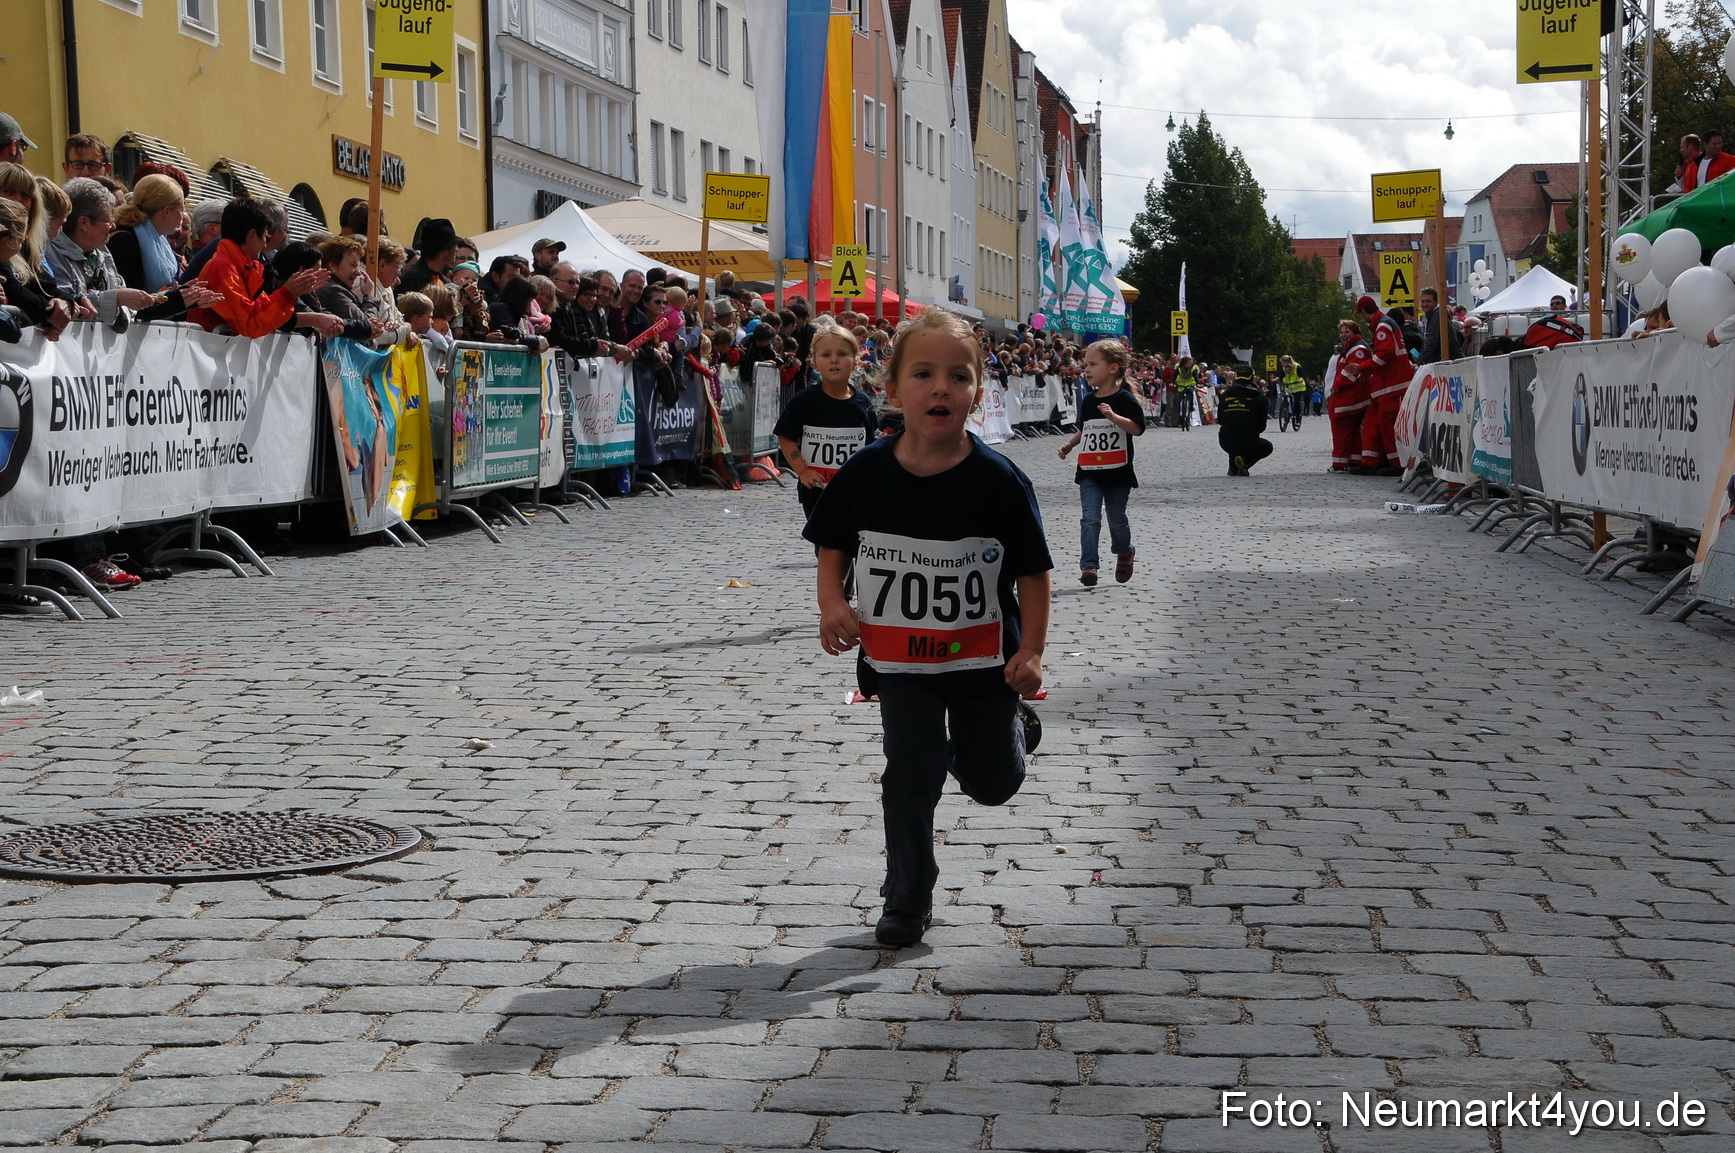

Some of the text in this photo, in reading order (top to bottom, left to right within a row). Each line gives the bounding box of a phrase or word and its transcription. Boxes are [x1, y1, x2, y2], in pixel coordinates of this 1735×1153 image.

[379, 0, 453, 16] Jugend-
[1519, 0, 1598, 15] Jugend-
[399, 15, 432, 34] lauf
[535, 4, 591, 54] BRILLEN WEBER
[1541, 14, 1577, 34] lauf
[708, 185, 765, 200] Schnupper-
[1375, 185, 1436, 197] Schnupper-
[726, 200, 745, 211] lauf
[1396, 198, 1417, 209] lauf
[835, 246, 863, 258] Block
[1383, 254, 1414, 265] Block
[838, 260, 858, 287] A
[1388, 268, 1410, 296] A
[1175, 319, 1184, 331] B
[1268, 360, 1275, 368] C
[49, 375, 248, 435] BMW EfficientDynamics
[486, 400, 523, 420] Mehr Sicherheit
[1593, 385, 1621, 429] BMW
[486, 427, 495, 446] für
[503, 426, 518, 444] Event!
[803, 431, 824, 440] PARTL
[1082, 431, 1120, 452] 7382
[48, 450, 103, 492] Weniger
[166, 438, 193, 472] Mehr
[860, 544, 977, 569] PARTL Neumarkt
[869, 567, 987, 623] 7059
[907, 635, 949, 658] Mia
